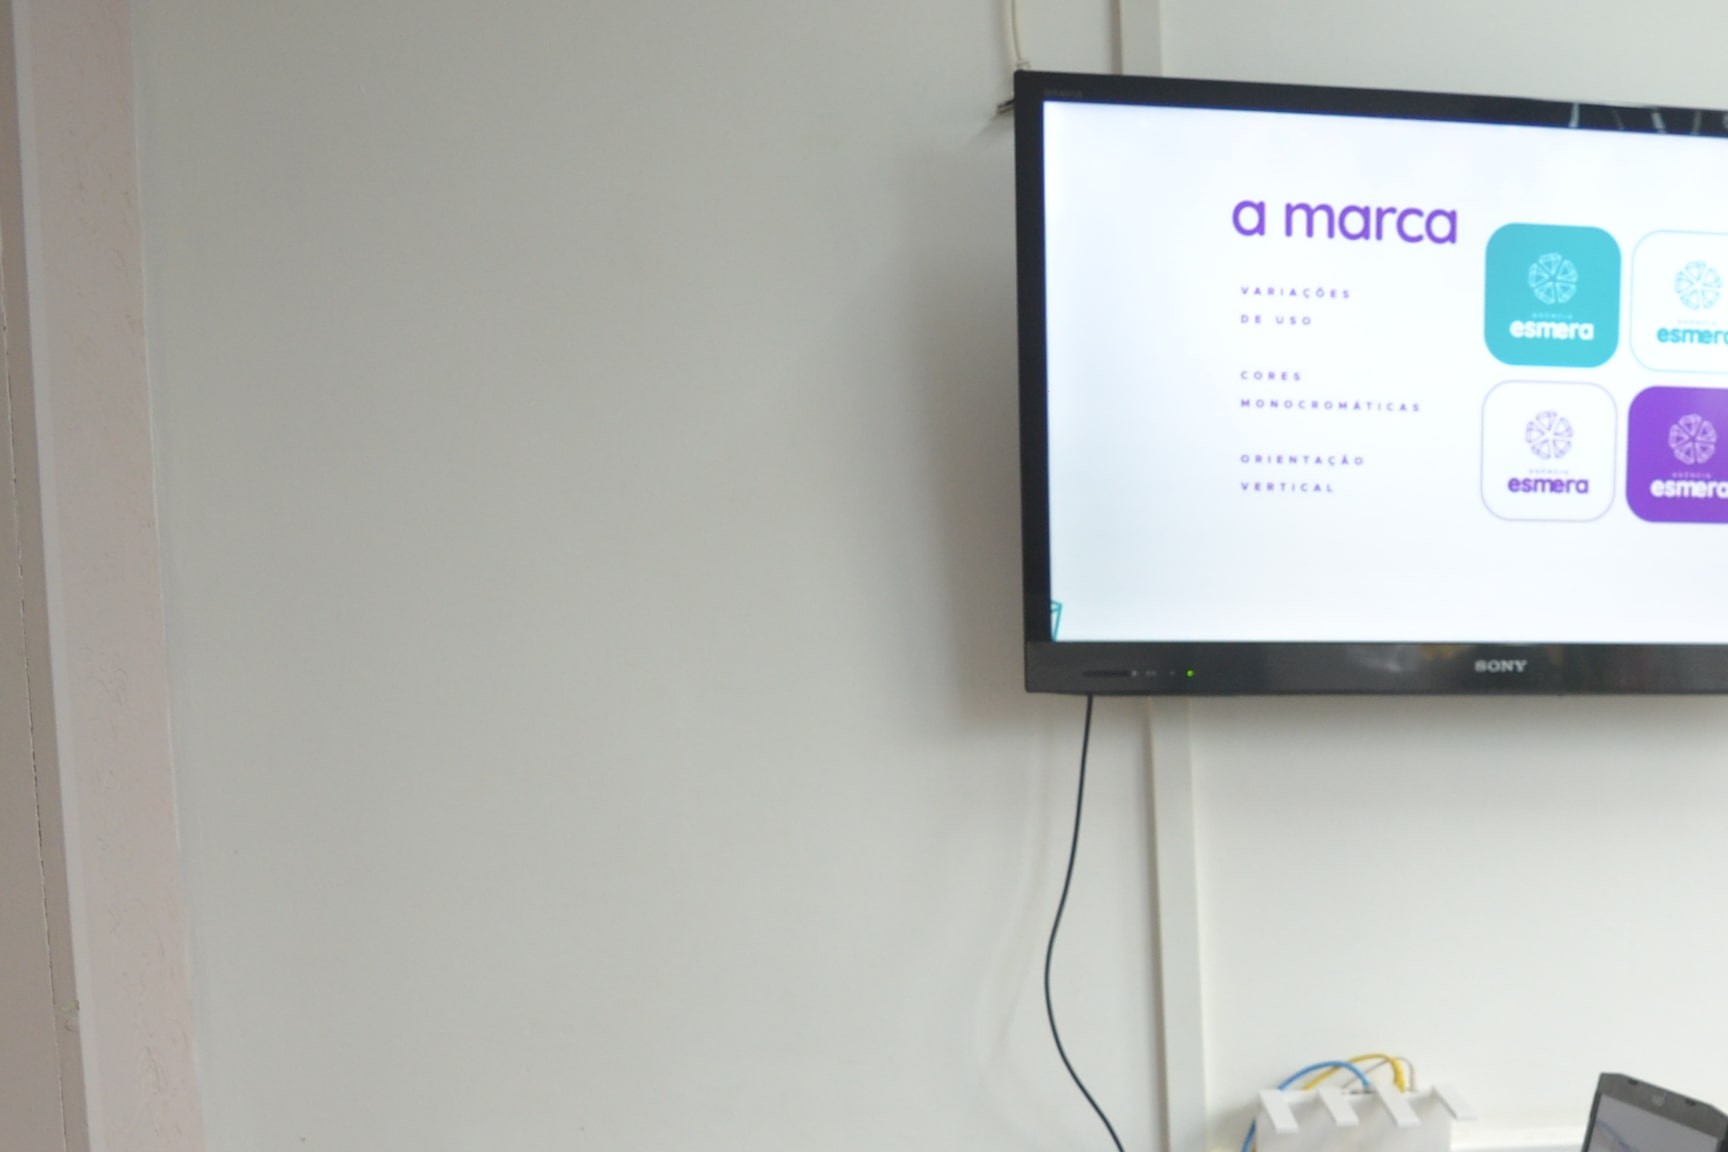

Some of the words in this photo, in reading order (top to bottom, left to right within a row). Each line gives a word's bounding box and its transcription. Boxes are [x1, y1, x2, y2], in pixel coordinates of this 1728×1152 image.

[1232, 200, 1265, 236] a
[1285, 202, 1458, 245] marca
[1240, 286, 1350, 299] VARIAÇÕES
[1240, 314, 1262, 324] DE
[1275, 316, 1311, 326] USO
[1509, 320, 1595, 340] esmera
[1240, 370, 1302, 381] CORES
[1240, 398, 1420, 412] MONOCROMÁTICAS
[1240, 453, 1364, 467] ORIENTAÇÃO
[1240, 481, 1334, 492] VERTICAL
[1507, 477, 1589, 494] esmera
[1474, 659, 1528, 673] SONY
